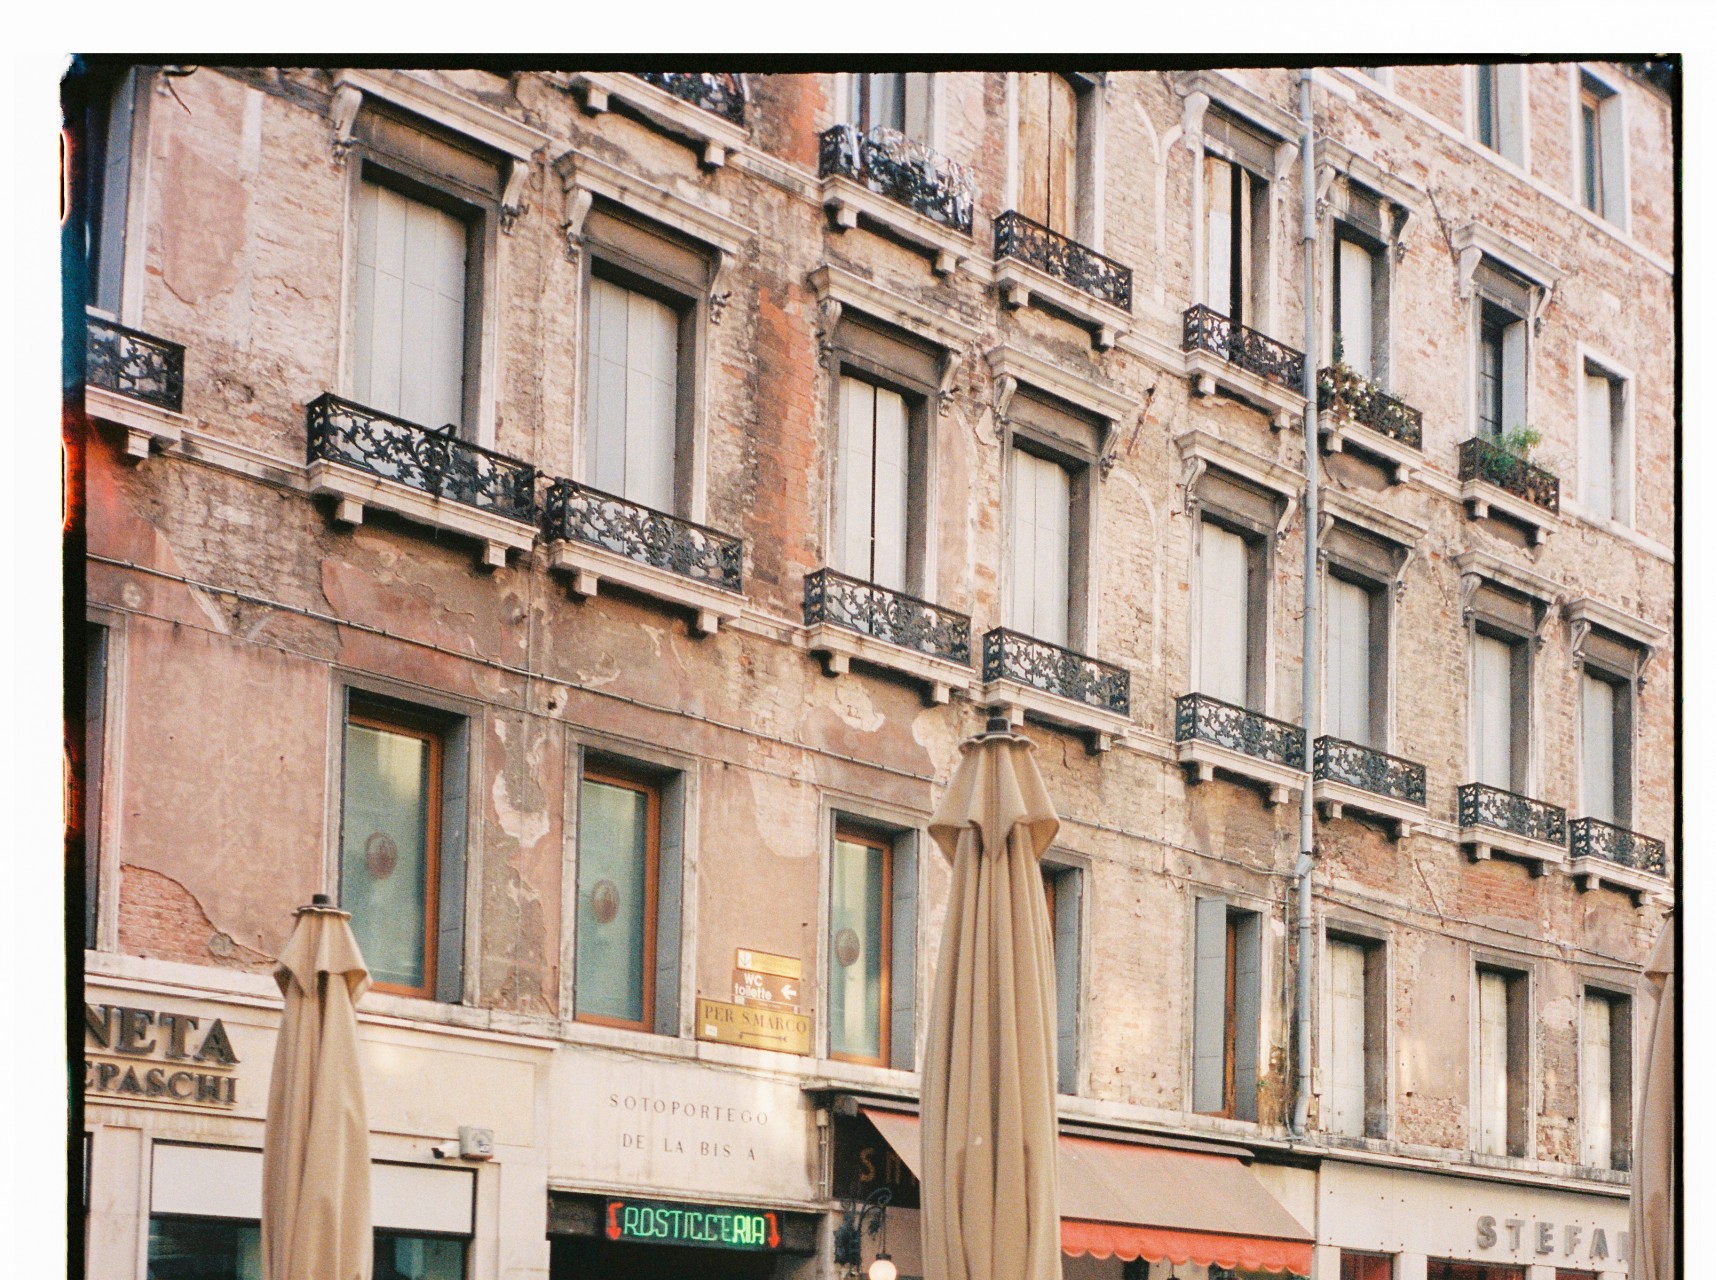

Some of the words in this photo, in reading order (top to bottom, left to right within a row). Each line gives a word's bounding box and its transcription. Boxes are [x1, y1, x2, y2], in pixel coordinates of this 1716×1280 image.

[743, 972, 764, 987] WC
[734, 983, 773, 1001] toilette
[705, 1005, 733, 1023] PER
[609, 1093, 768, 1125] SOTOPORTEGO
[623, 1133, 645, 1149] DE
[664, 1138, 684, 1153] LA
[623, 1206, 766, 1245] ROSTICCERIA
